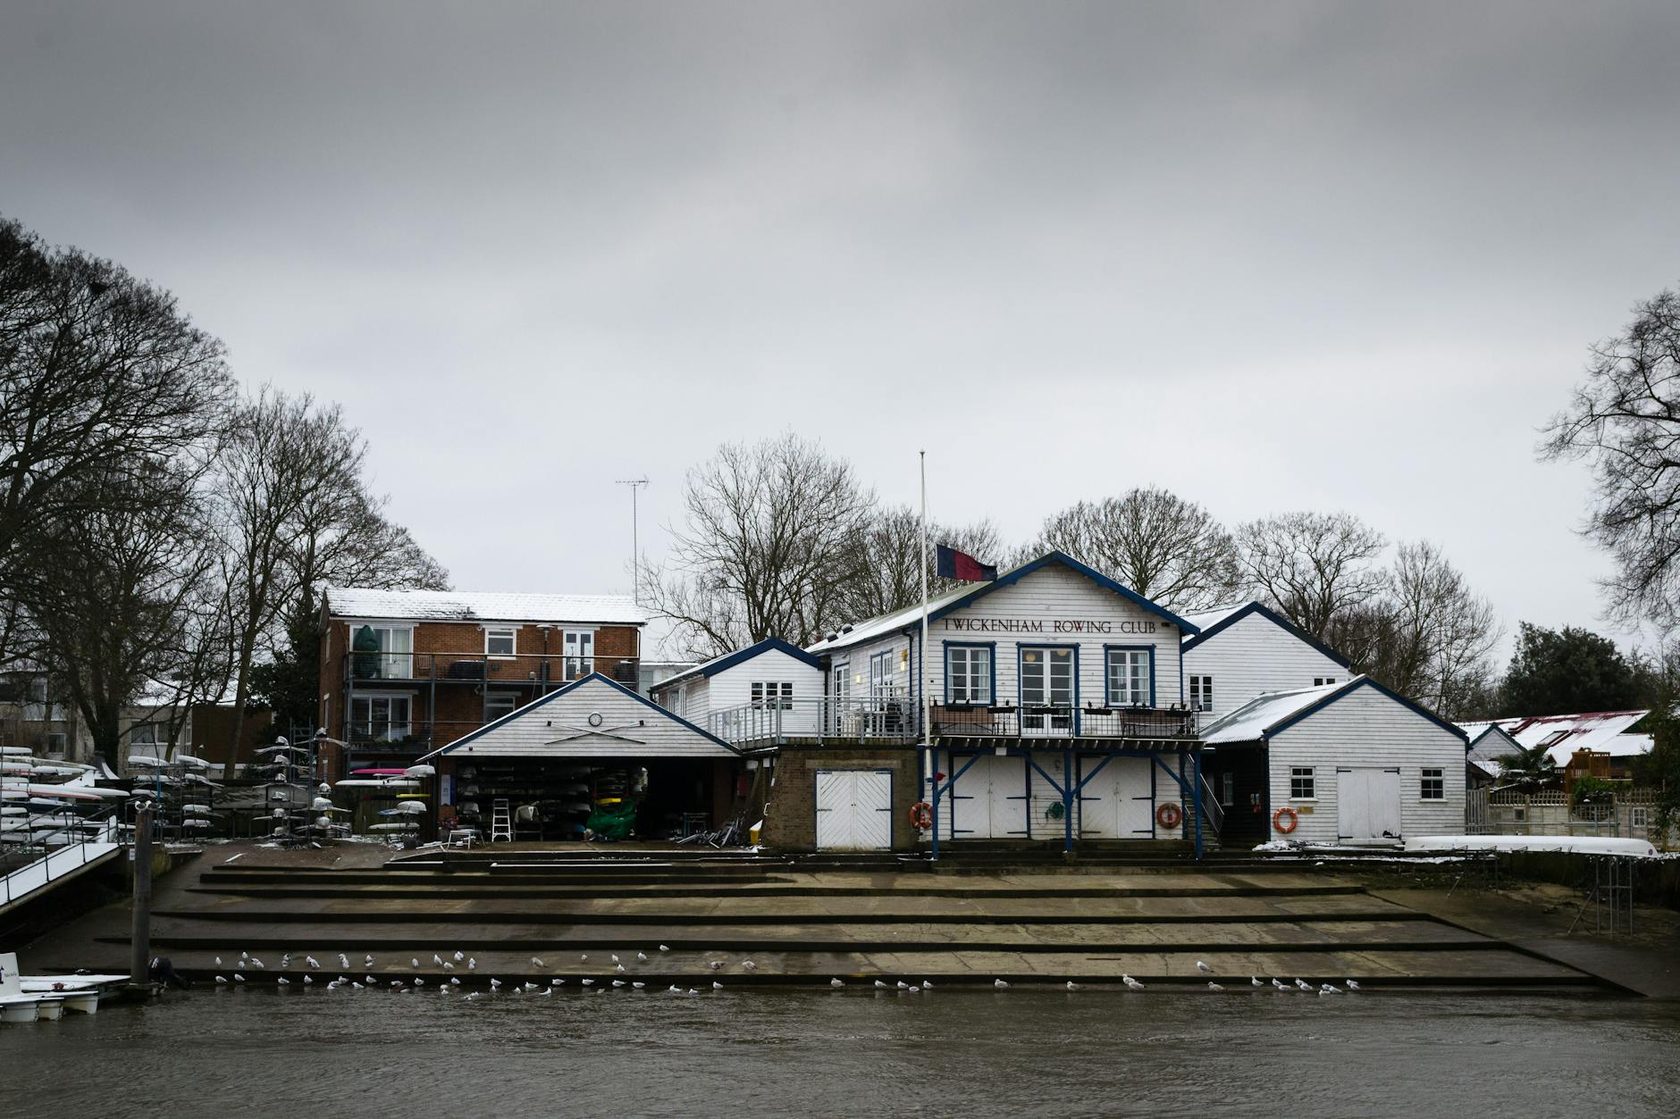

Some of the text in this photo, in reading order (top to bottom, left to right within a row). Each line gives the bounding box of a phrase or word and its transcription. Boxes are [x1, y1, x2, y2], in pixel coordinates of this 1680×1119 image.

[944, 618, 1156, 633] TWICKENHAM ROWING CLUB
